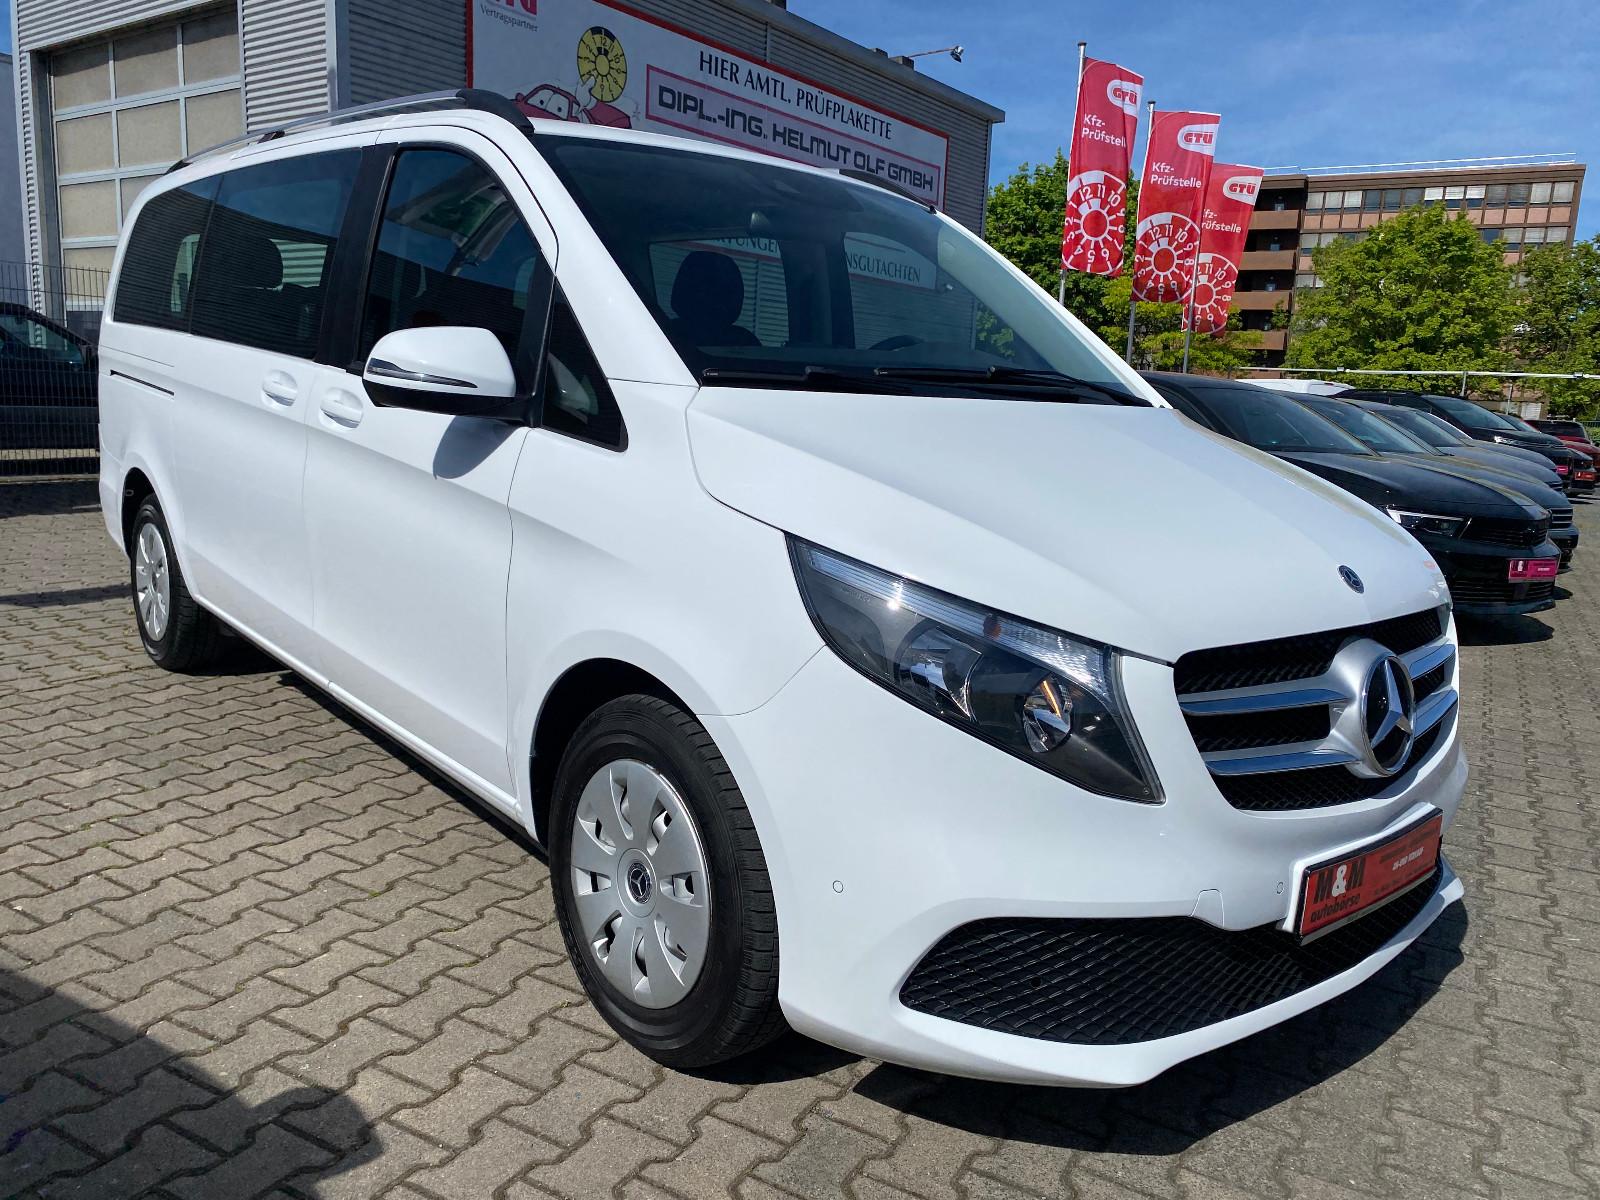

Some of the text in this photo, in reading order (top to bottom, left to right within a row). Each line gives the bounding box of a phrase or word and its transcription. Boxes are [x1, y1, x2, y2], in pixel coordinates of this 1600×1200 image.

[480, 3, 538, 32] Vertragspartner
[699, 50, 893, 140] HIER AMTL. PRÜFPLAKETTE
[1112, 87, 1138, 105] GTÜ
[1083, 113, 1106, 127] Kfz-
[1081, 127, 1126, 148] Prüfstell
[1183, 131, 1215, 146] GTÜ
[772, 123, 851, 165] HELMUT
[853, 150, 886, 175] OLF
[1152, 162, 1175, 173] Kfz-
[1150, 174, 1202, 188] Prüfstelle
[1079, 186, 1093, 201] 12
[1097, 184, 1106, 198] 11
[1228, 182, 1257, 196] GTÜ
[1108, 190, 1121, 207] 10
[1203, 208, 1218, 219] fz-
[1149, 227, 1162, 240] 12
[1165, 225, 1173, 237] 11
[1201, 221, 1242, 233] rüfstelle
[1175, 228, 1188, 243] 10
[1313, 858, 1366, 904] M&M
